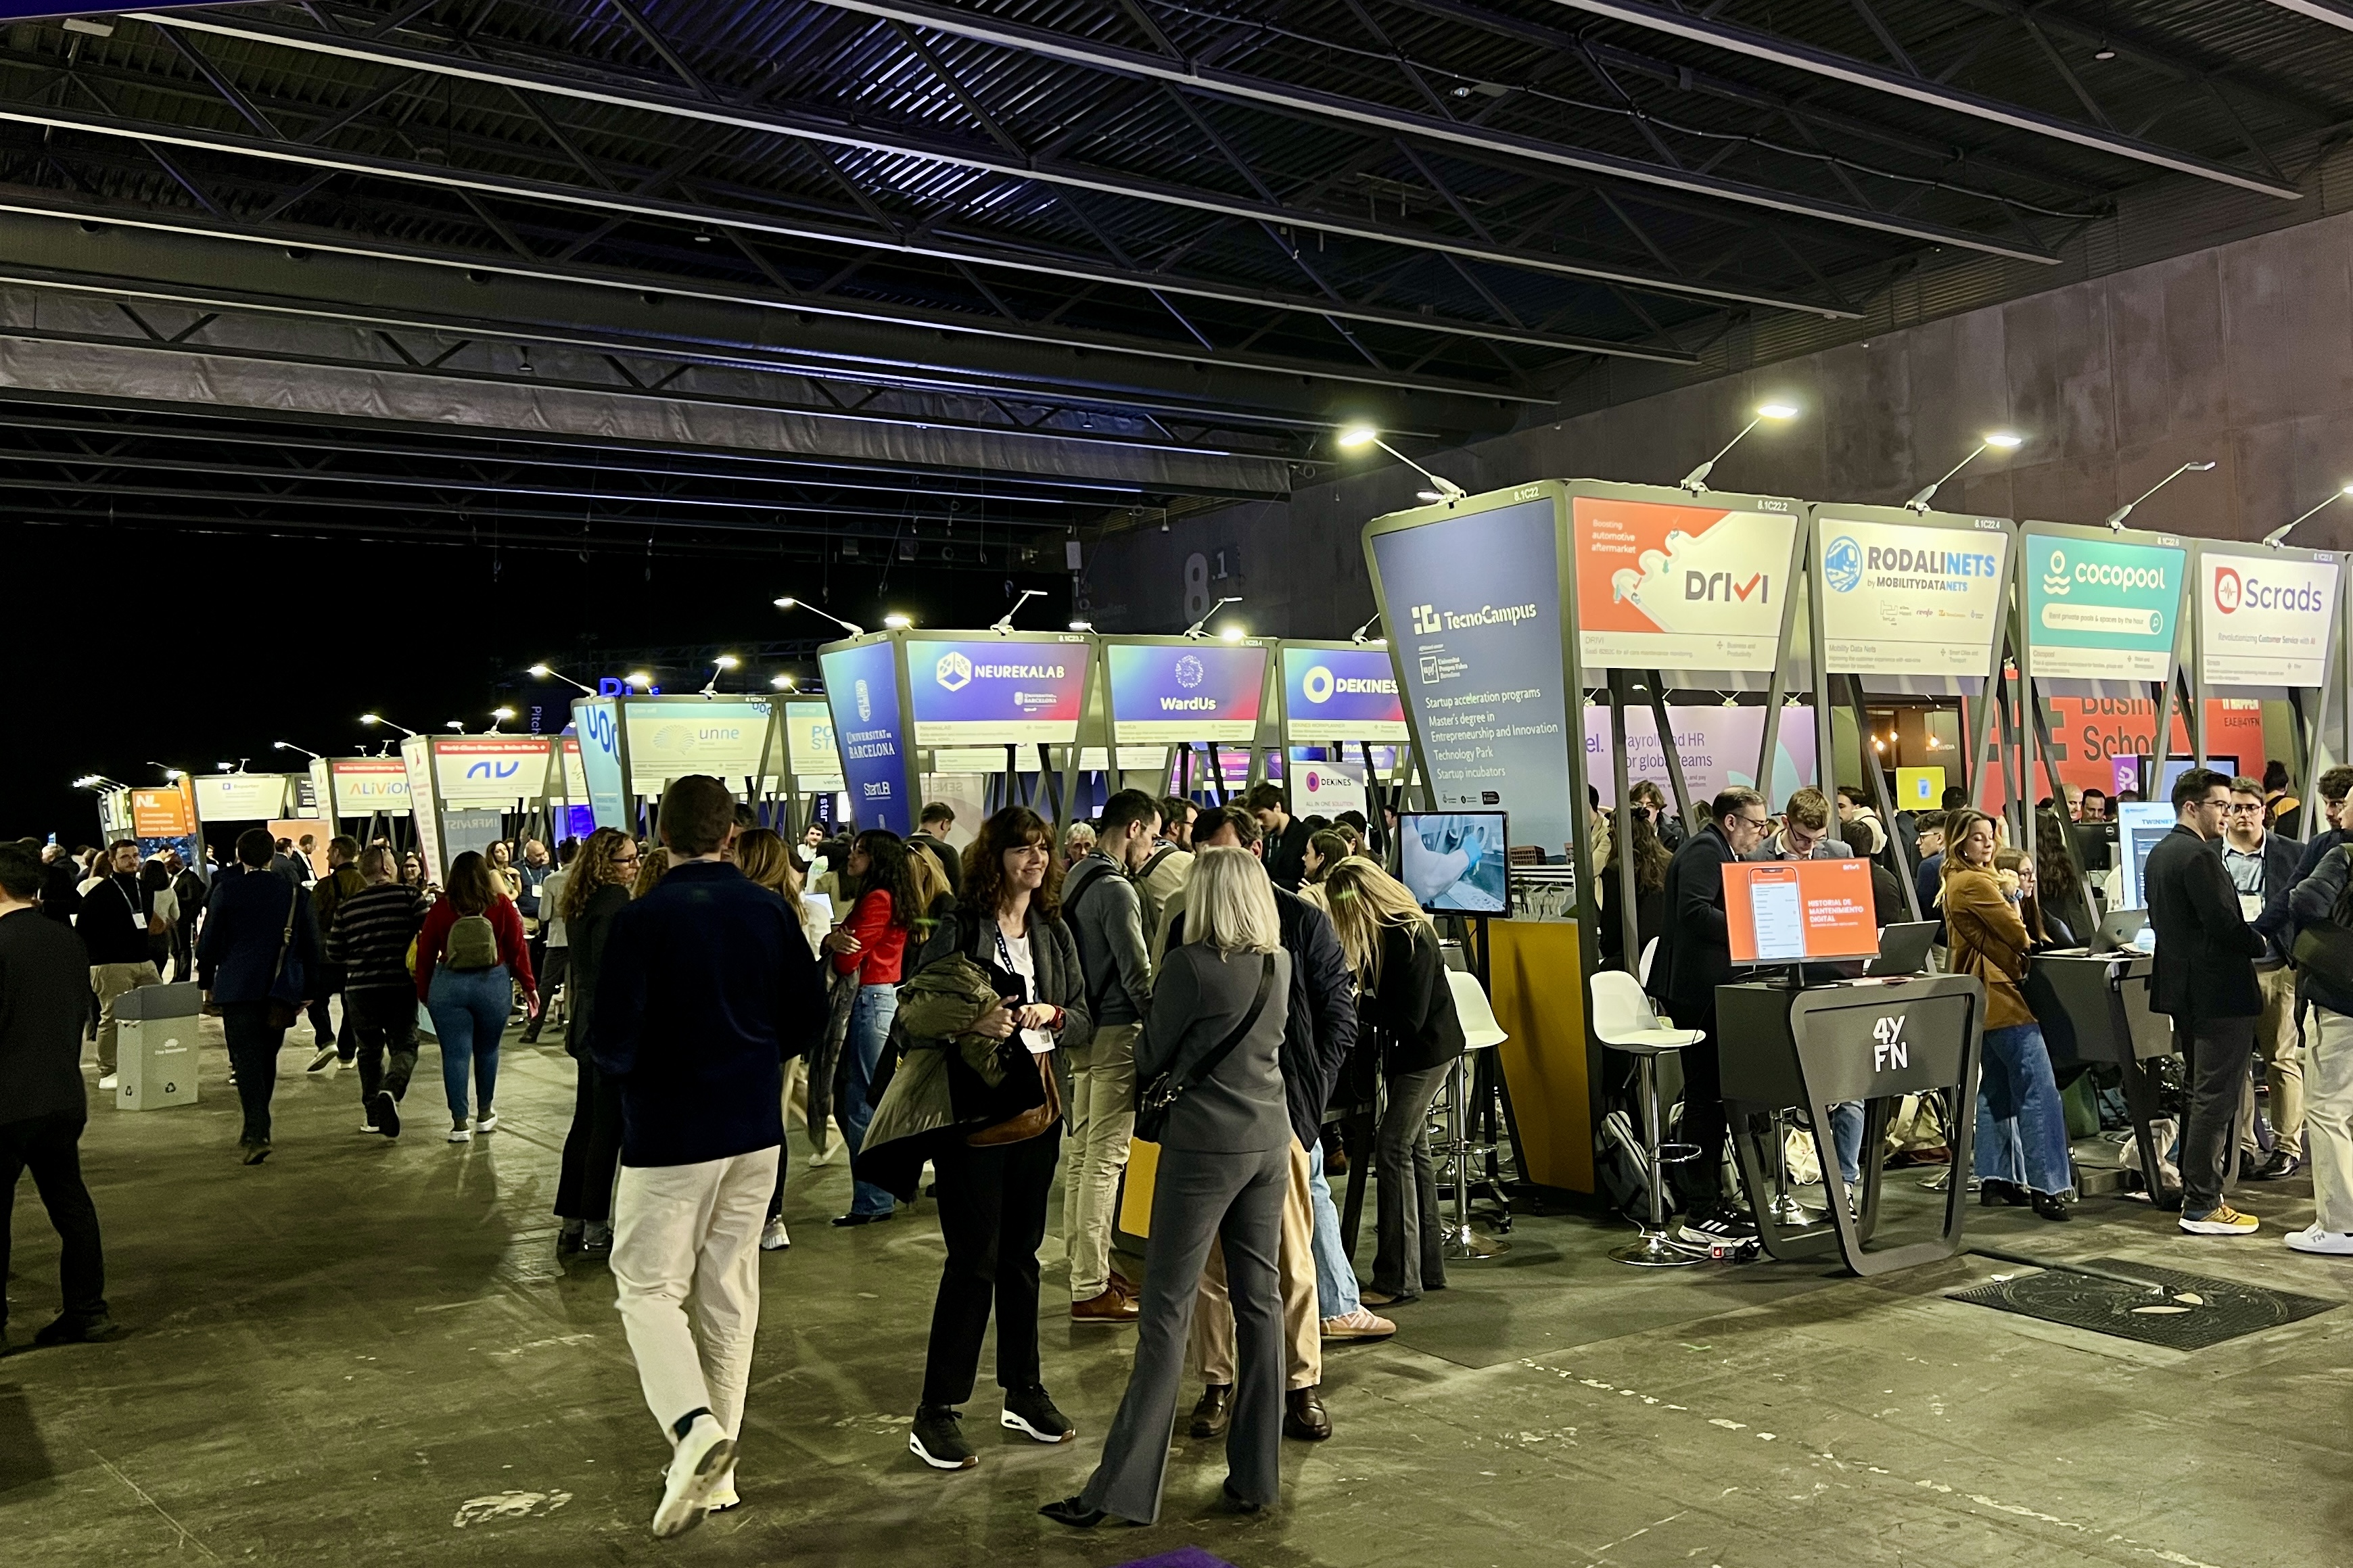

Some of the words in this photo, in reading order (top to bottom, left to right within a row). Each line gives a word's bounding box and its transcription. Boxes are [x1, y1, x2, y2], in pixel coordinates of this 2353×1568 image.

[1514, 487, 1539, 501] 8.1C22
[1757, 500, 1788, 511] 8.1C22.2
[1593, 519, 1623, 530] Boosting
[1974, 519, 2001, 529] 8.1C22.4
[1591, 531, 1635, 542] automotive
[1591, 542, 1636, 554] aftermarket
[1867, 546, 1995, 577] RODALINETS
[1867, 579, 1876, 589] by
[1876, 577, 1967, 592] MOBILITYDATANETS
[2075, 563, 2165, 592] cocopool
[2245, 578, 2322, 613] Scrads
[1444, 604, 1537, 629] TecnoCampus
[2118, 617, 2124, 625] by
[2258, 634, 2281, 644] Customer
[974, 665, 1065, 678] NEUREKALAB
[1336, 678, 1399, 694] DEKINES
[1160, 696, 1217, 710] WardUs
[1425, 696, 1453, 709] Startup
[1454, 691, 1501, 706] acceleration
[1501, 688, 1541, 703] programs
[1428, 713, 1460, 728] Master's
[1460, 712, 1486, 727] degree
[1487, 711, 1495, 722] in
[699, 728, 739, 740] unne
[1430, 727, 1495, 744] Entrepreneurship
[1495, 725, 1512, 738] and
[1512, 721, 1558, 736] Innovation
[1625, 733, 1659, 751] ayroll
[1672, 732, 1685, 747] nd
[1687, 732, 1705, 746] HR
[848, 742, 895, 759] BARCELONA
[1433, 748, 1474, 762] Technology
[1475, 745, 1494, 759] Park
[1626, 756, 1637, 768] or
[1639, 753, 1667, 771] glob
[1679, 755, 1713, 767] eams
[1437, 768, 1464, 781] Startup
[1465, 765, 1506, 778] incubators
[1321, 778, 1351, 786] DEKINES
[136, 794, 161, 807] NL
[1807, 899, 1842, 907] HISTORIAL
[1809, 906, 1864, 915] MANTENIMIENTO
[1873, 1015, 1905, 1044] 4Y
[1874, 1041, 1908, 1072] FN
